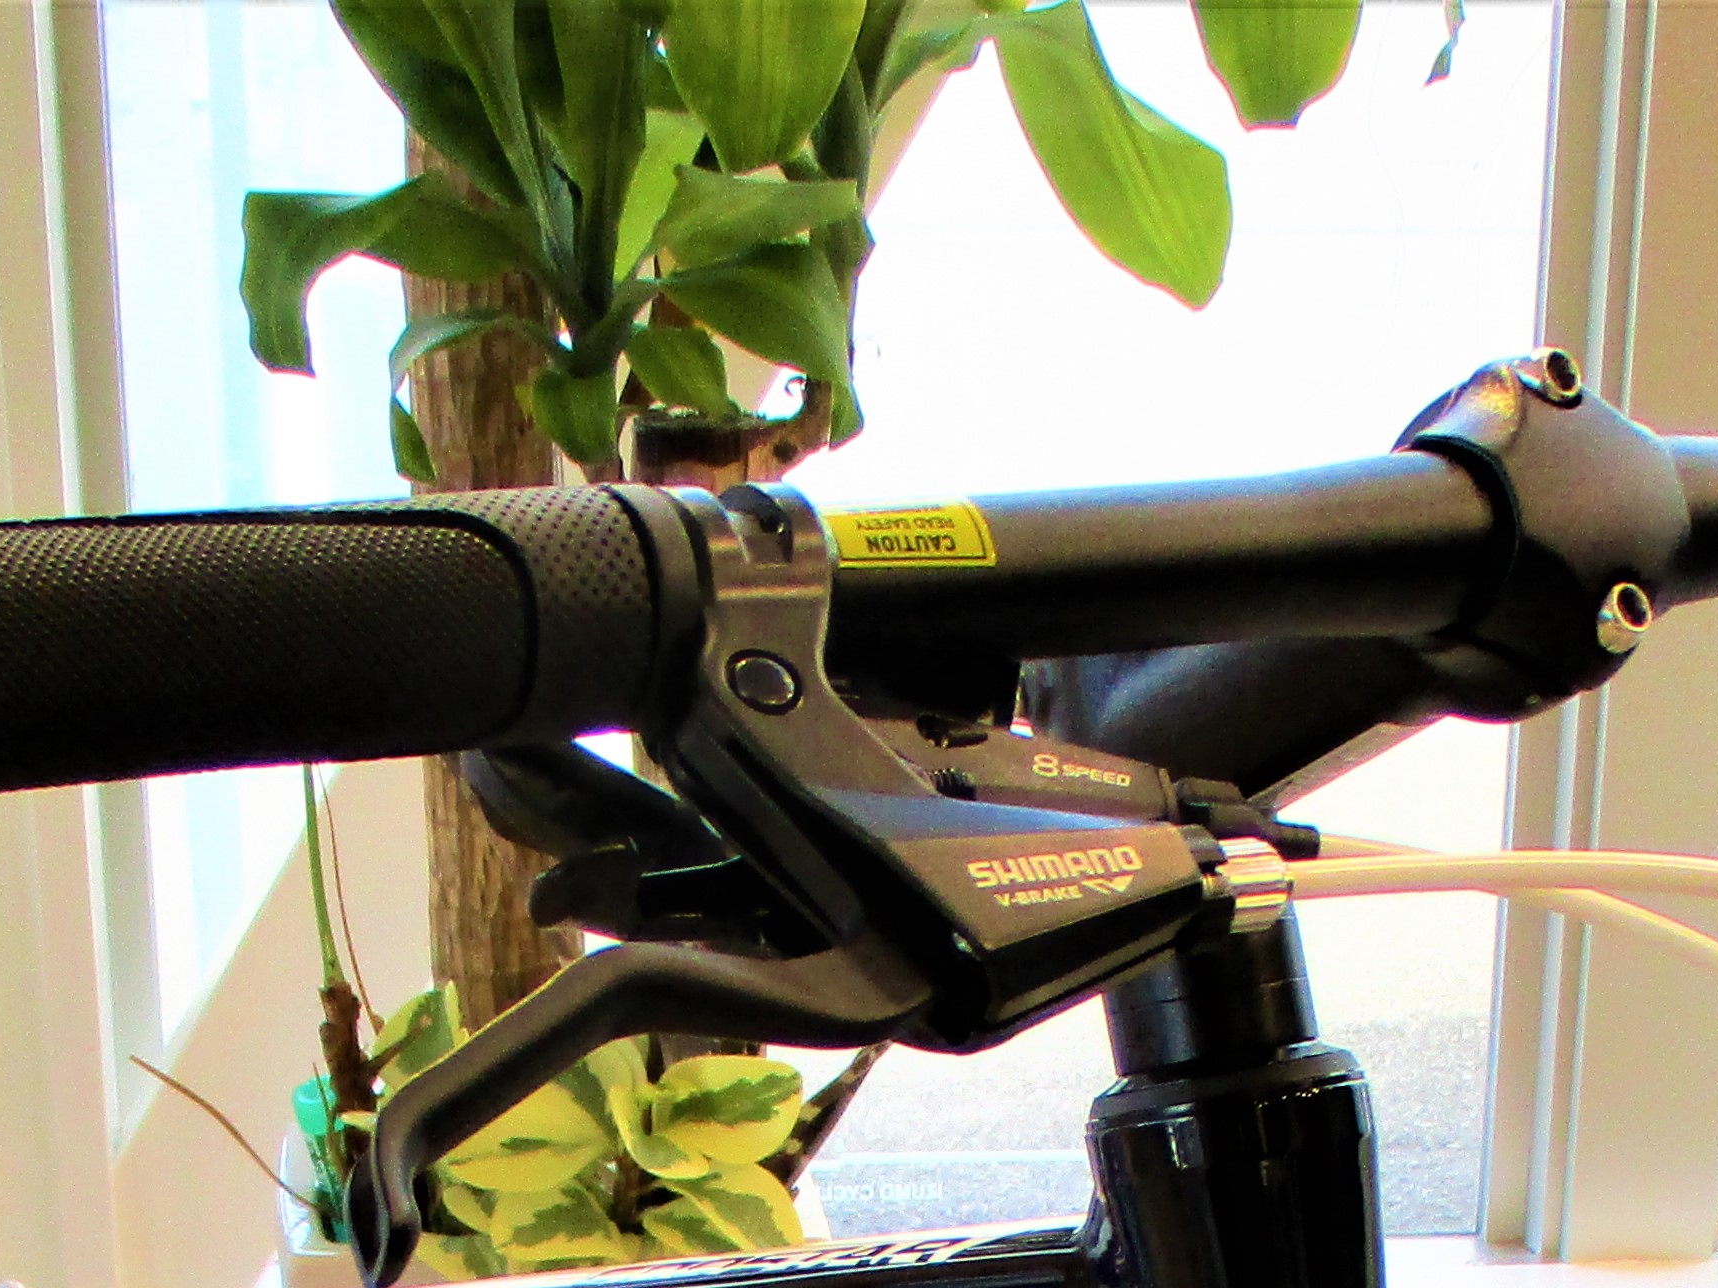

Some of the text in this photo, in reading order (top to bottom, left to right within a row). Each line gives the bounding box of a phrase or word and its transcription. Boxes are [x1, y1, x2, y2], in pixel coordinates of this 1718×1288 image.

[856, 517, 955, 531] READ SAFETY
[866, 534, 956, 553] CAUTION
[1032, 753, 1132, 788] 8 SPEED
[966, 844, 1145, 889] SHIMANO
[993, 884, 1084, 908] V-BRAKE
